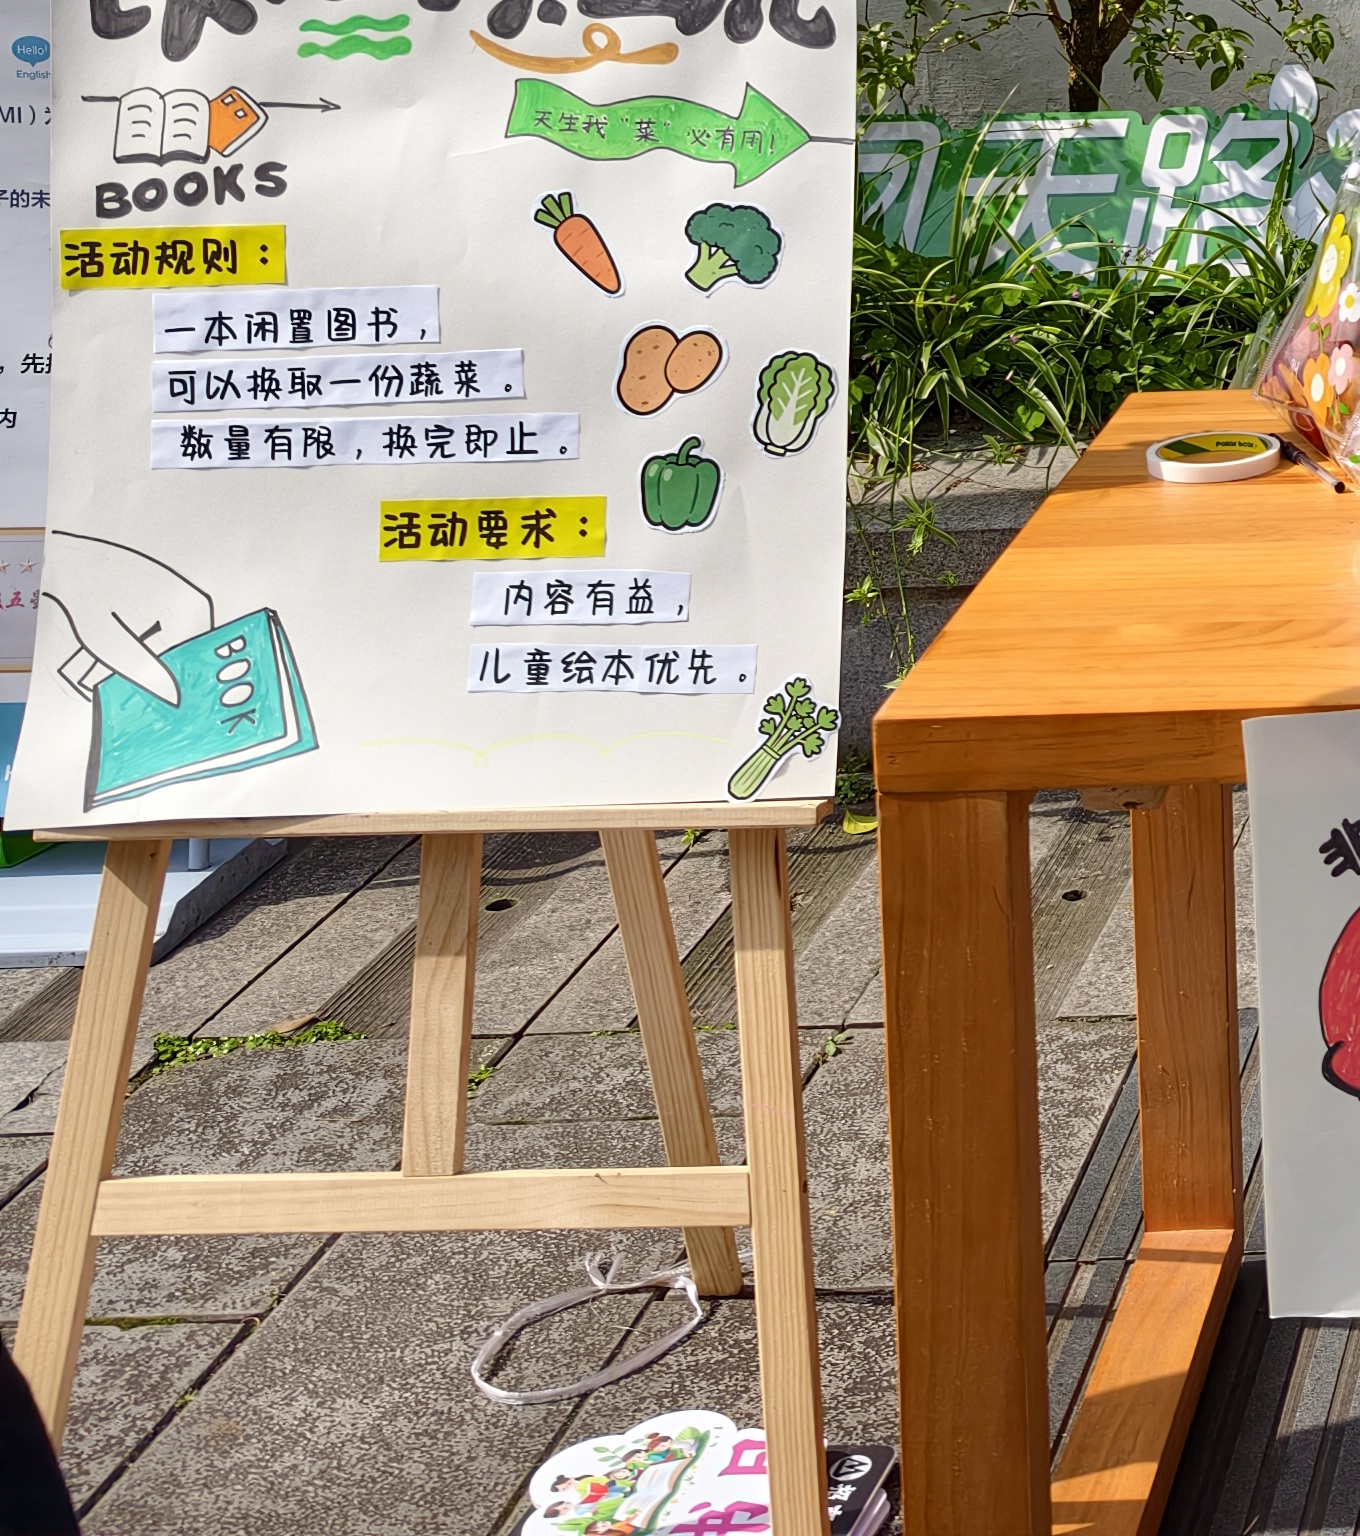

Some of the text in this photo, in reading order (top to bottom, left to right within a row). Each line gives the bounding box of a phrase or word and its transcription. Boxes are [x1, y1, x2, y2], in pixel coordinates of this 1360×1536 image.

[95, 161, 289, 220] BOOKS
[64, 228, 272, 280] 活动规则：
[164, 306, 429, 346] 一本闲置图书，
[167, 359, 517, 404] 可以换取一份蔬菜。
[181, 420, 572, 461] 数量有限，换完即止。
[383, 509, 590, 549] 活动要求：
[503, 572, 687, 623] 内容有益，
[213, 633, 257, 735] BOOK
[479, 647, 751, 688] 儿童绘本优先。
